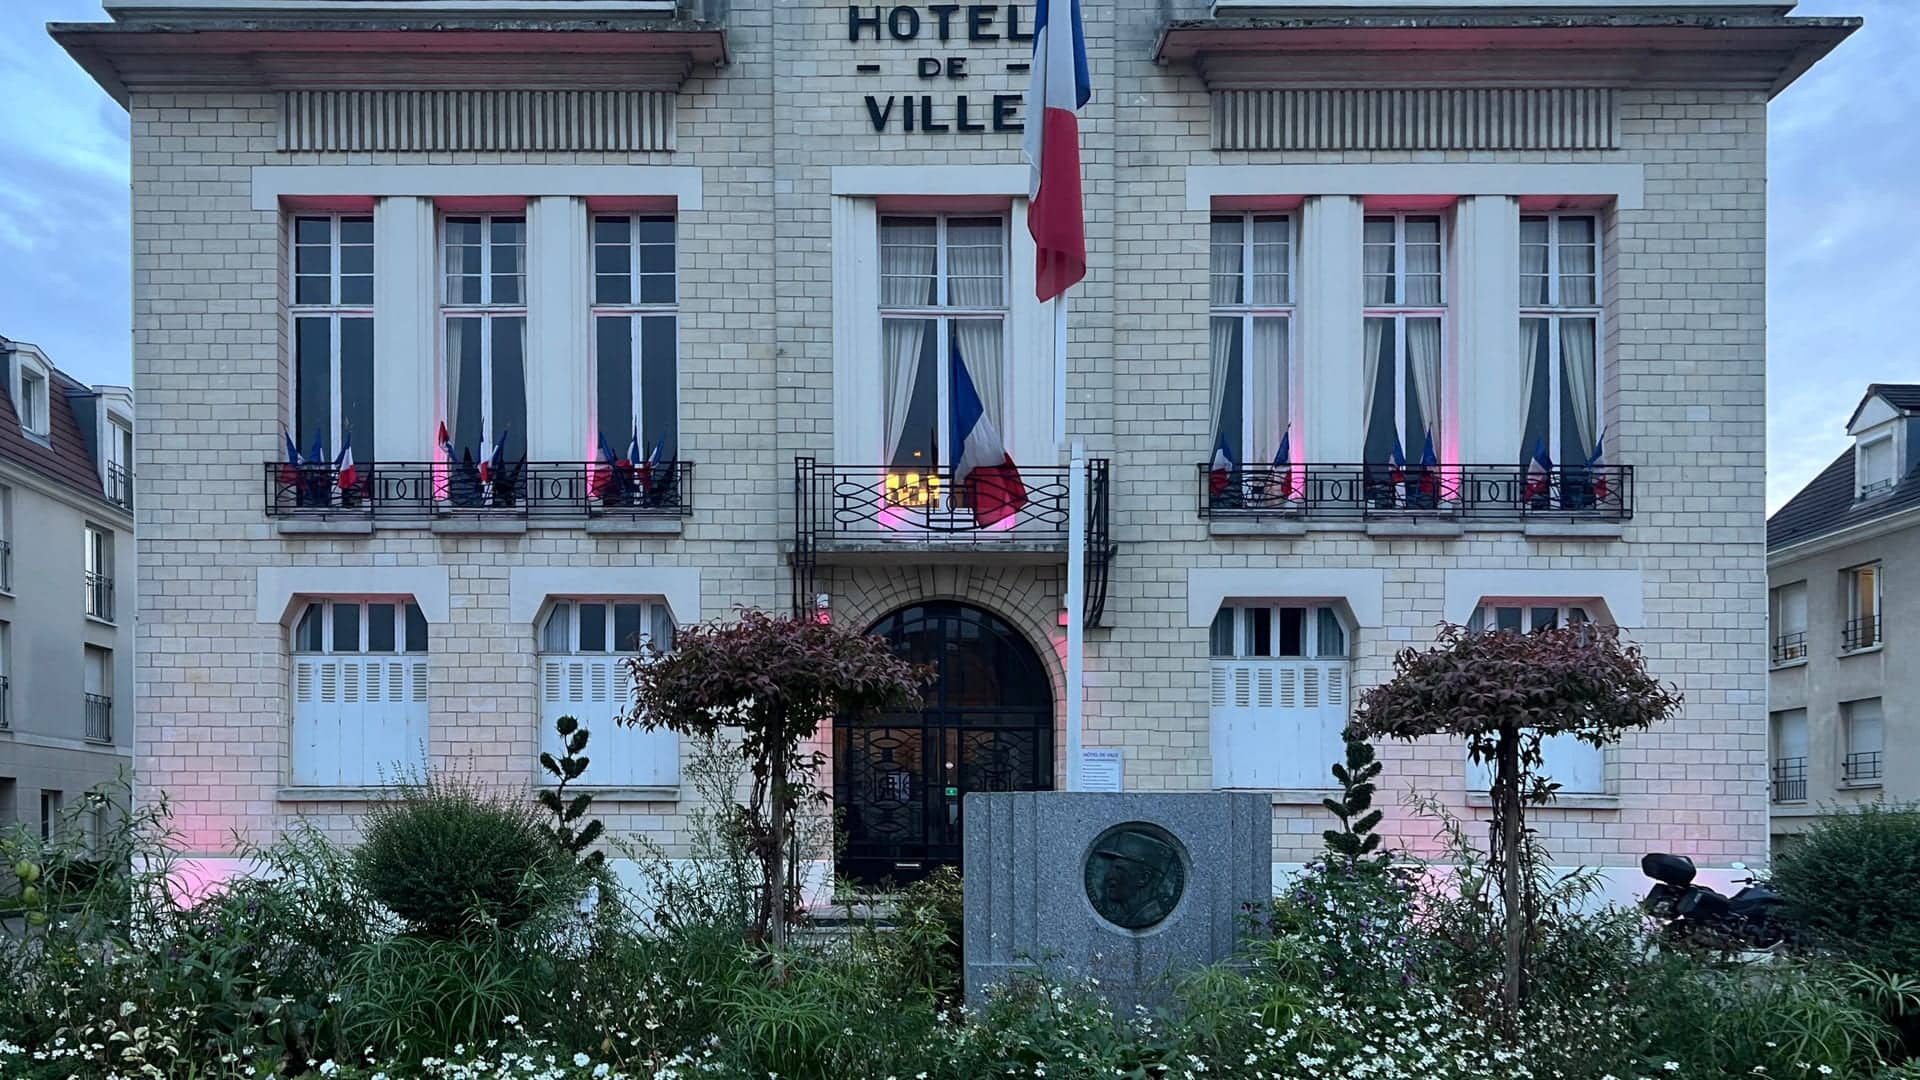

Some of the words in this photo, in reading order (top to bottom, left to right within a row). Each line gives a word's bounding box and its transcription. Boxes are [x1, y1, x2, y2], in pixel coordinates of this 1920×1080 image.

[848, 4, 1034, 42] HOTEL
[918, 56, 968, 78] DE
[864, 94, 1025, 133] VILLE
